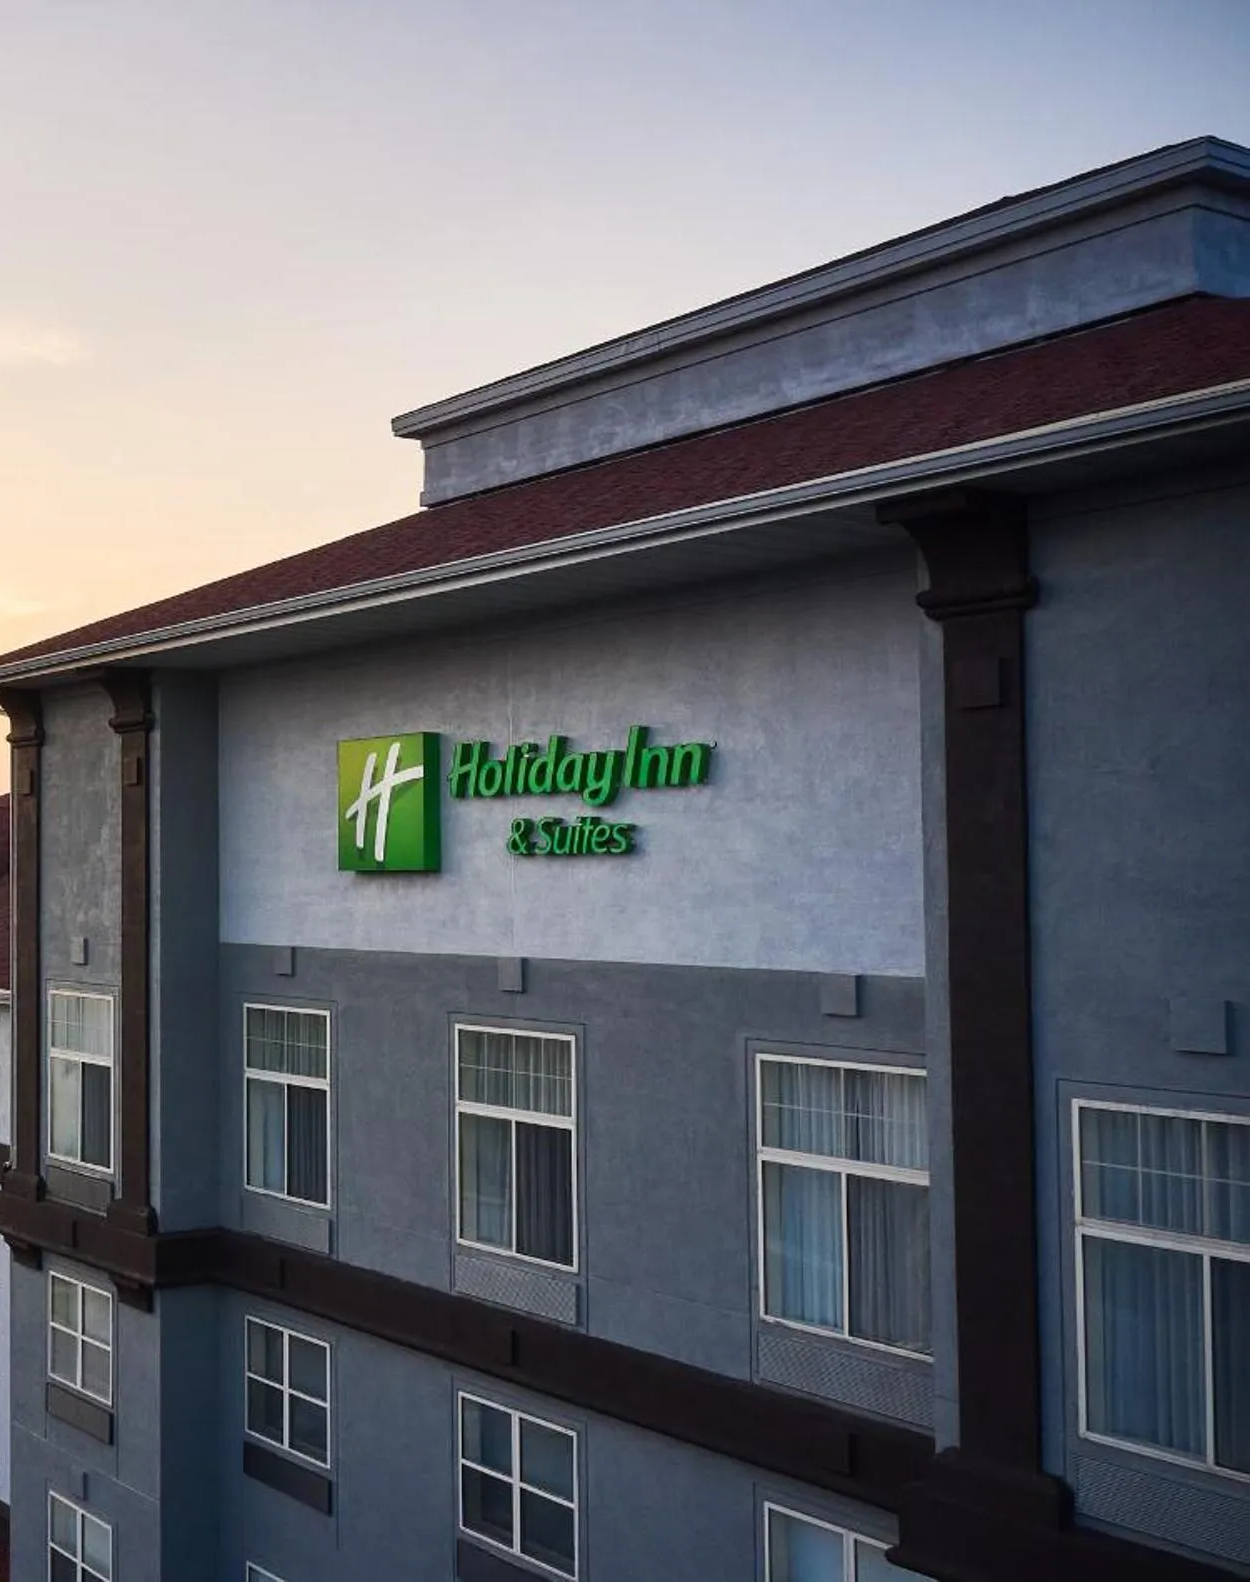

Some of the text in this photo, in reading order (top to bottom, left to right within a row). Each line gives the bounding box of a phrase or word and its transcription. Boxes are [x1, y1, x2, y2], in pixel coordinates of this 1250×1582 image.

[448, 734, 623, 805] Holiday
[508, 816, 634, 855] & Suites
